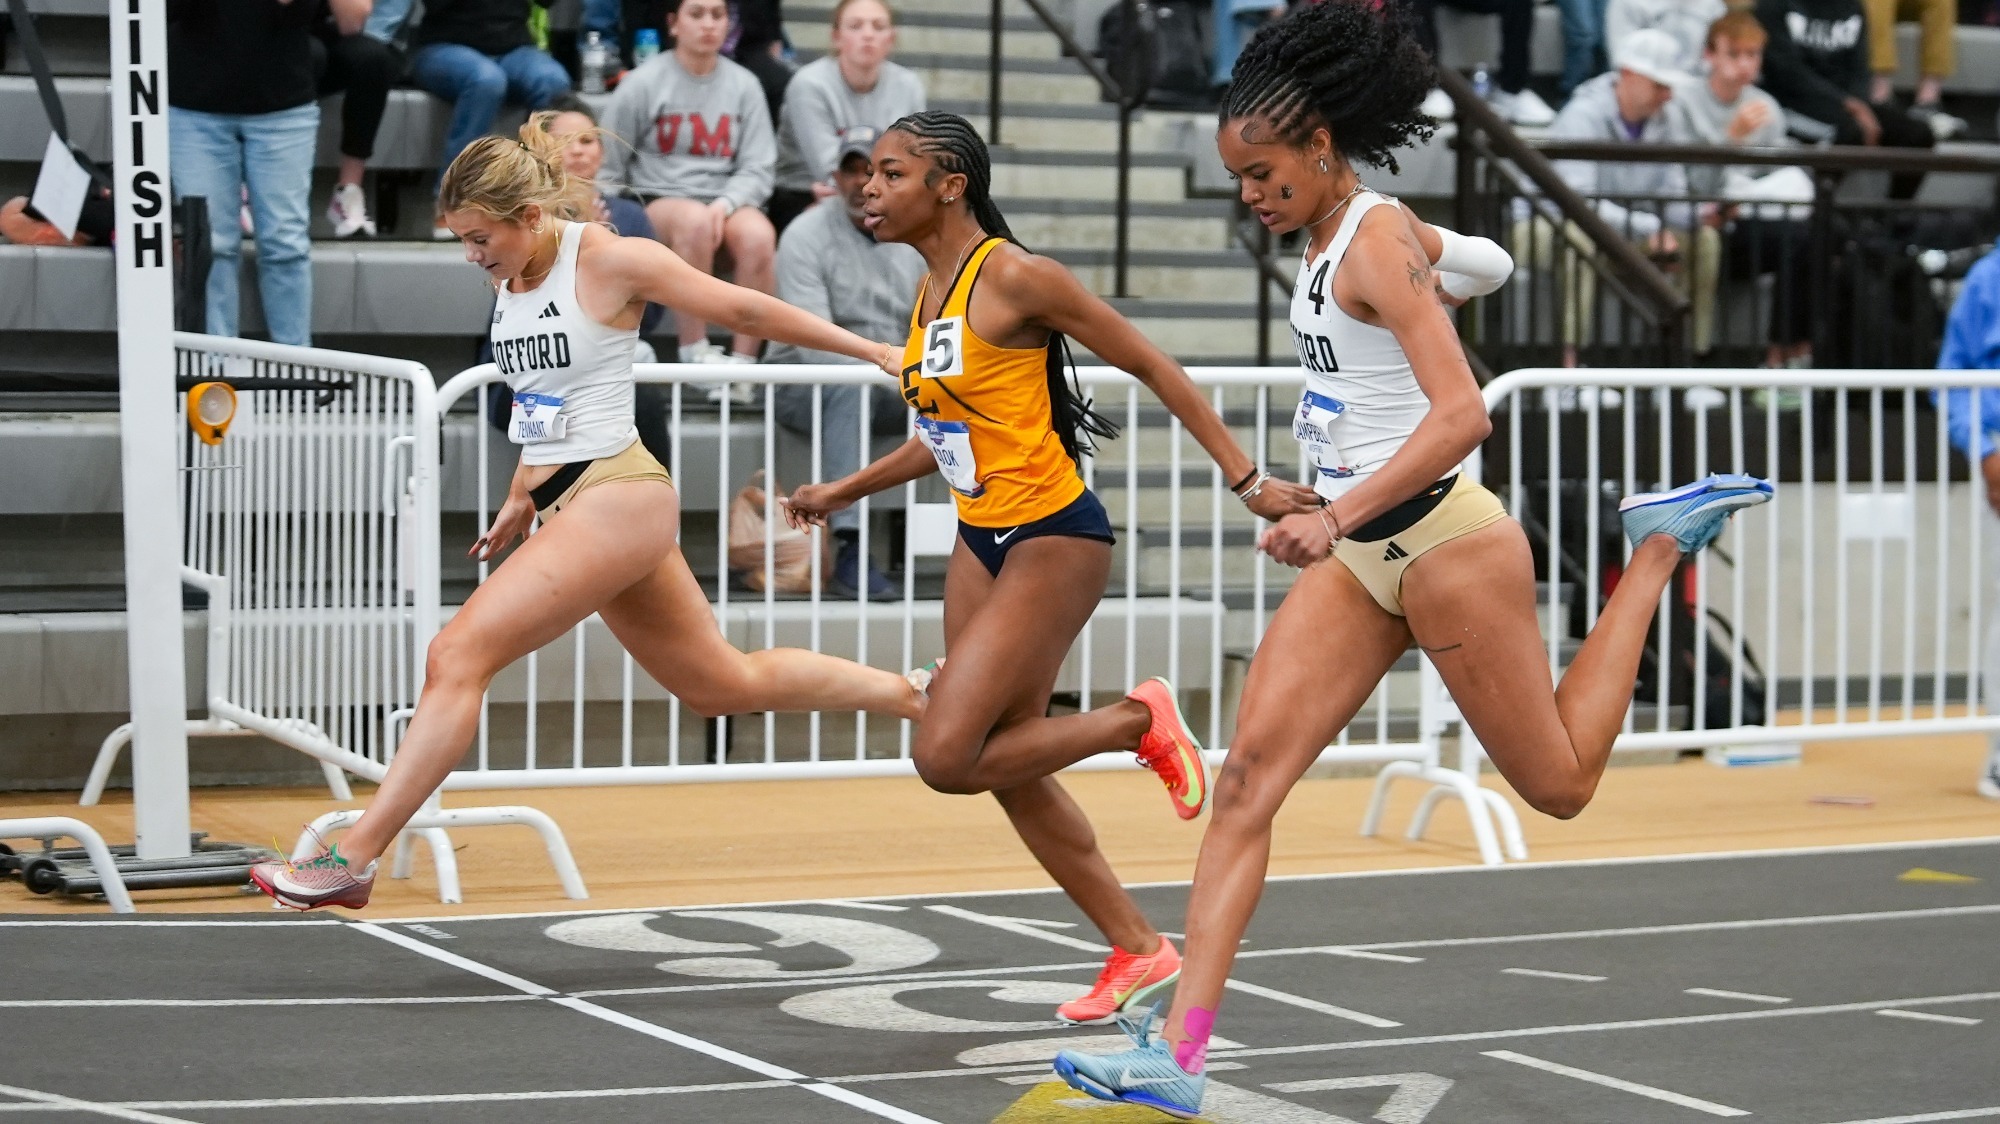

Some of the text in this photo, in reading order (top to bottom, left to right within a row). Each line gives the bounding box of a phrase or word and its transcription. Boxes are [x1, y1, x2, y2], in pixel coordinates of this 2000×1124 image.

[1308, 259, 1331, 316] 4
[926, 322, 954, 373] 5
[517, 420, 548, 438] TENNANT
